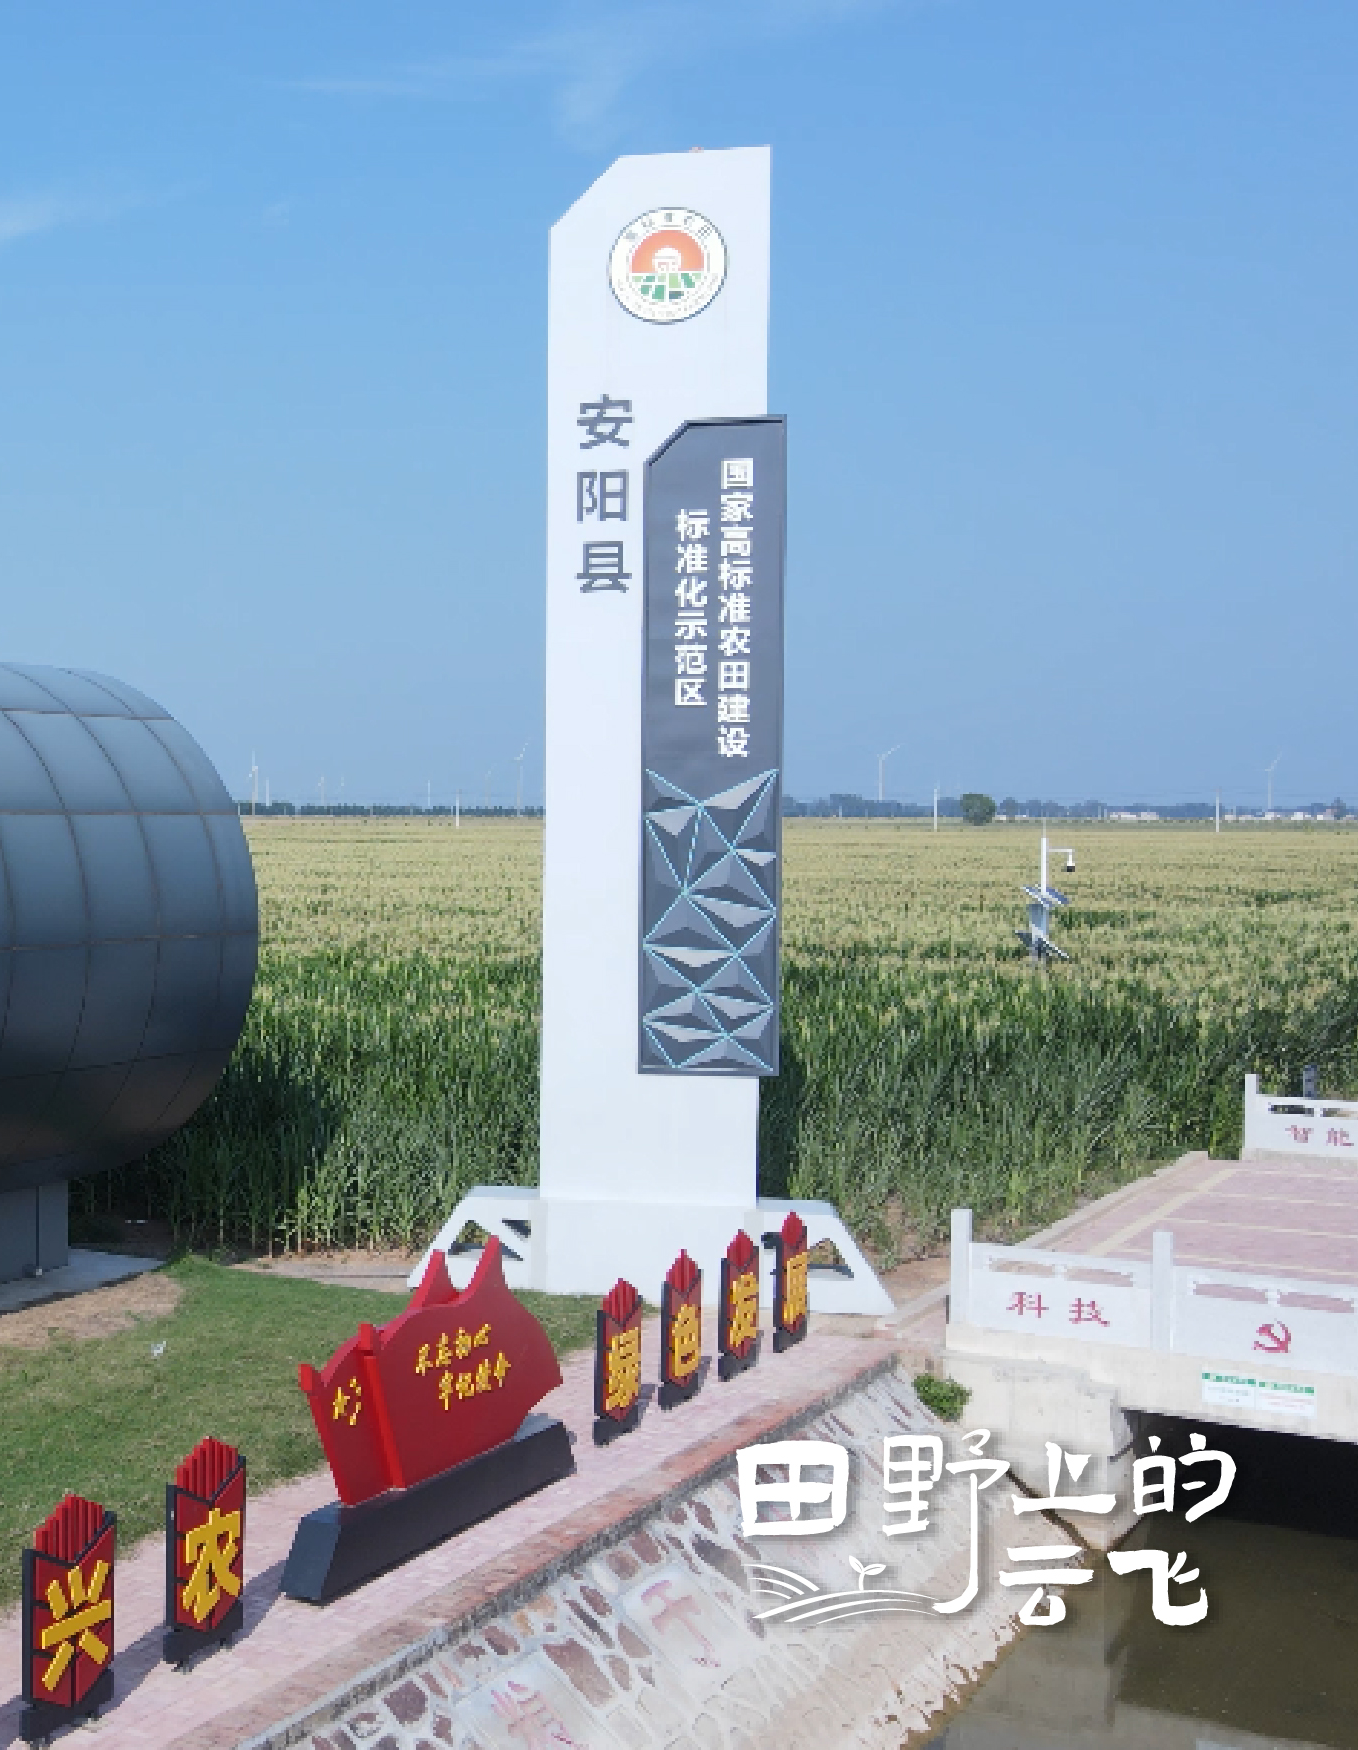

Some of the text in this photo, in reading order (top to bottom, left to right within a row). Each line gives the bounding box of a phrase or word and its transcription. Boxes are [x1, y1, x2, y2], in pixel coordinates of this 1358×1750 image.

[575, 393, 635, 593] 安阳县
[675, 508, 710, 707] 标准化示范区
[718, 457, 754, 757] 国家高标准农田建设
[1006, 1291, 1110, 1328] 科技
